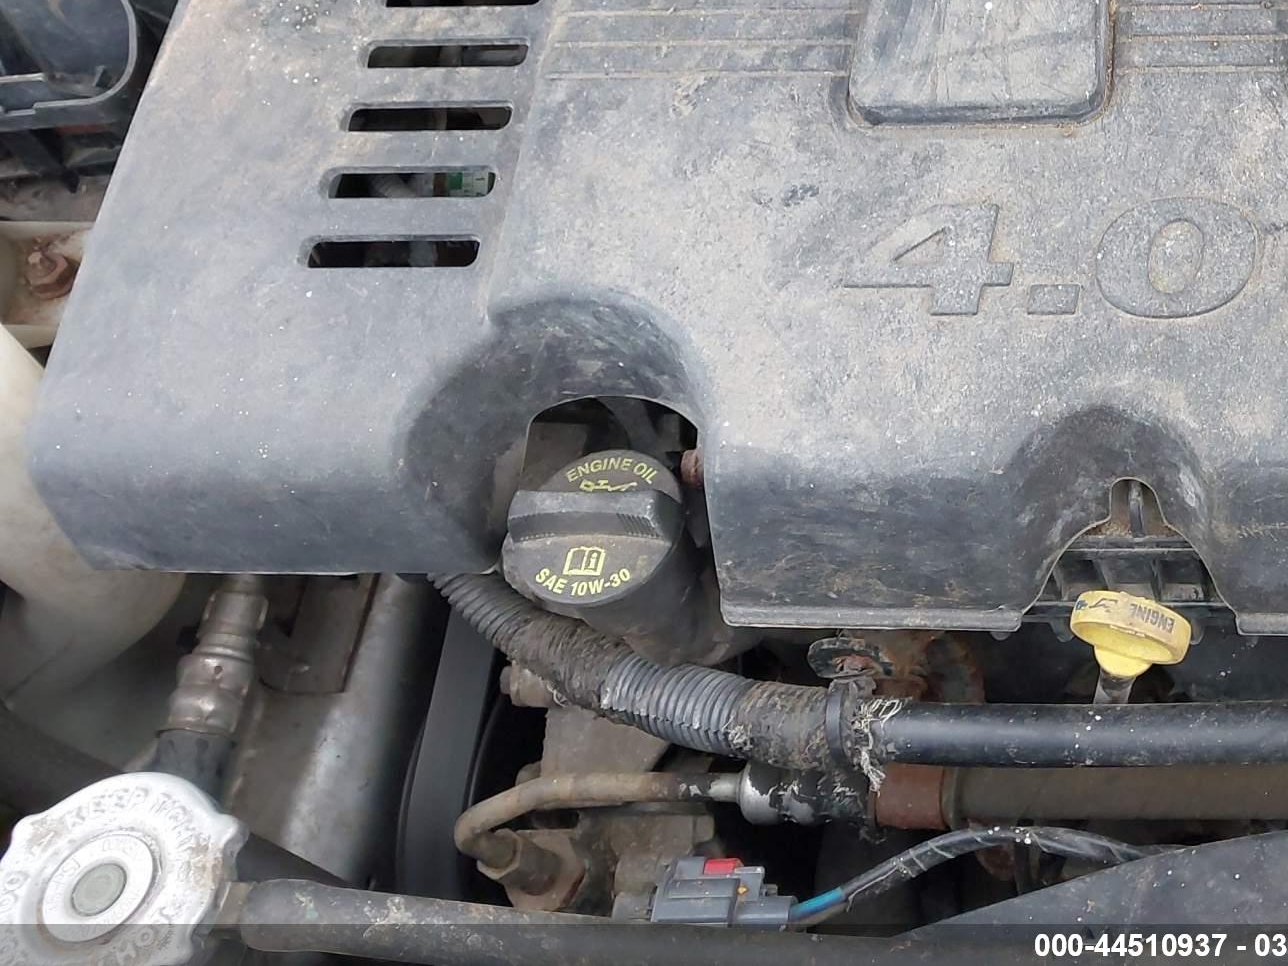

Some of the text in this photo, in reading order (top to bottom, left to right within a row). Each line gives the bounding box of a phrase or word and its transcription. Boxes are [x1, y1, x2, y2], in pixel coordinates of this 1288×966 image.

[565, 457, 658, 485] ENGINE OIL
[535, 567, 631, 596] SAE 10W-30
[1130, 603, 1175, 634] ENGINE
